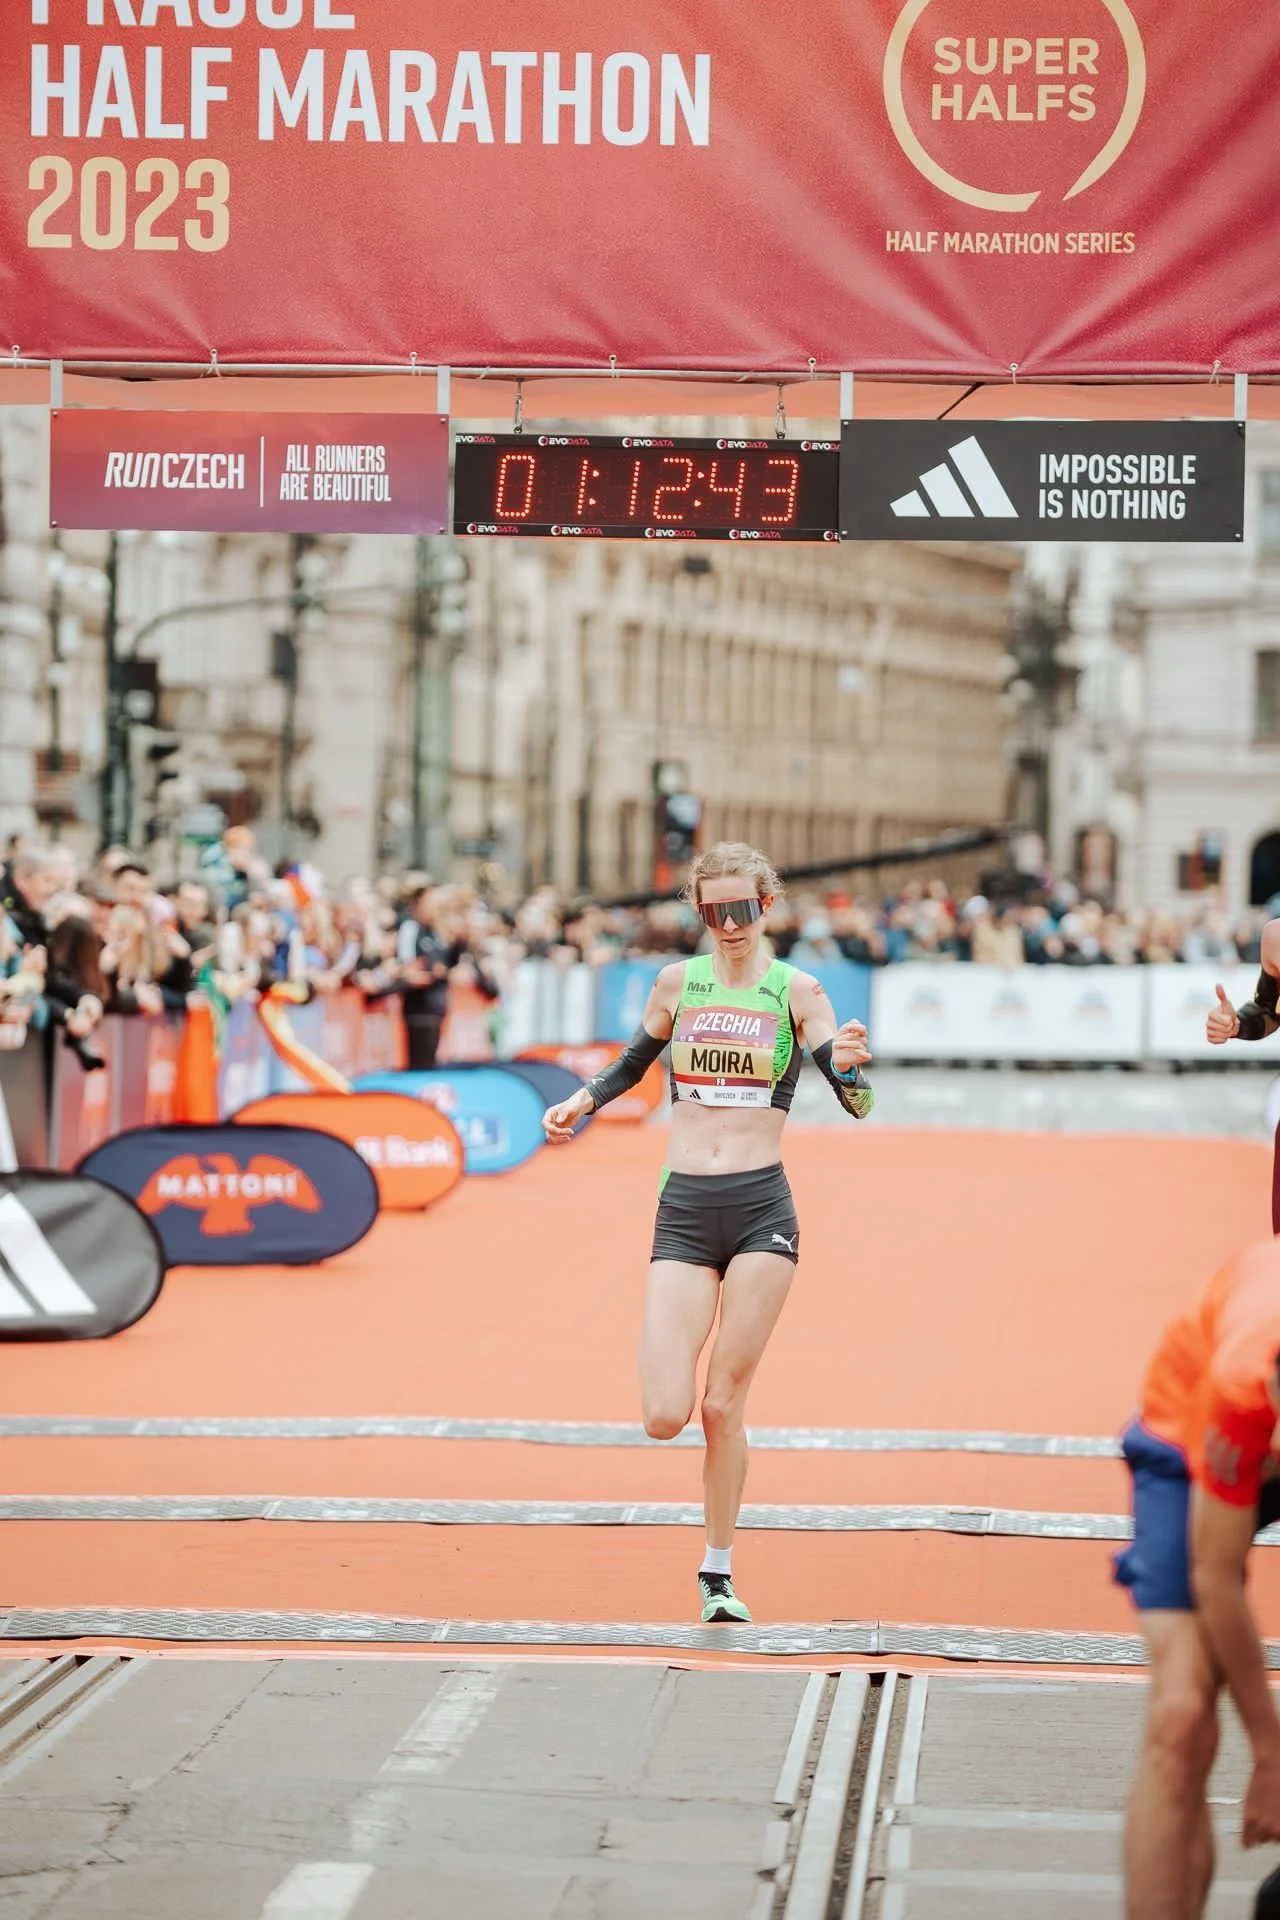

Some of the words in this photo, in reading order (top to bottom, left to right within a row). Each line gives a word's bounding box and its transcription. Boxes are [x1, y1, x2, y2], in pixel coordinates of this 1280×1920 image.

[934, 37, 1100, 75] SUPER
[30, 44, 232, 140] HALF
[258, 48, 711, 146] MARATHON
[931, 83, 1096, 122] HALFS
[27, 155, 230, 252] 2023
[886, 231, 938, 253] HALF
[943, 232, 1060, 254] MARATHON
[1065, 232, 1136, 255] SERIES
[549, 437, 590, 446] EVODATA
[632, 439, 674, 448] EVODATA
[727, 440, 769, 449] EVODATA
[286, 444, 311, 472] ALL
[315, 444, 386, 473] RUNNERS
[1039, 453, 1197, 485] IMPOSSIBLE
[279, 472, 309, 501] ARE
[313, 474, 392, 502] BEAUTIFUL
[1038, 488, 1063, 519] IS
[1071, 489, 1187, 520] NOTHING
[478, 525, 519, 533] EVODATA
[561, 527, 603, 536] EVODATA
[655, 529, 697, 537] EVODATA
[740, 530, 781, 539] EVODATA
[687, 982, 715, 993] M&T
[692, 1012, 761, 1037] CZECHIA
[690, 1047, 755, 1075] MOIRA
[157, 1173, 297, 1199] MATTONI
